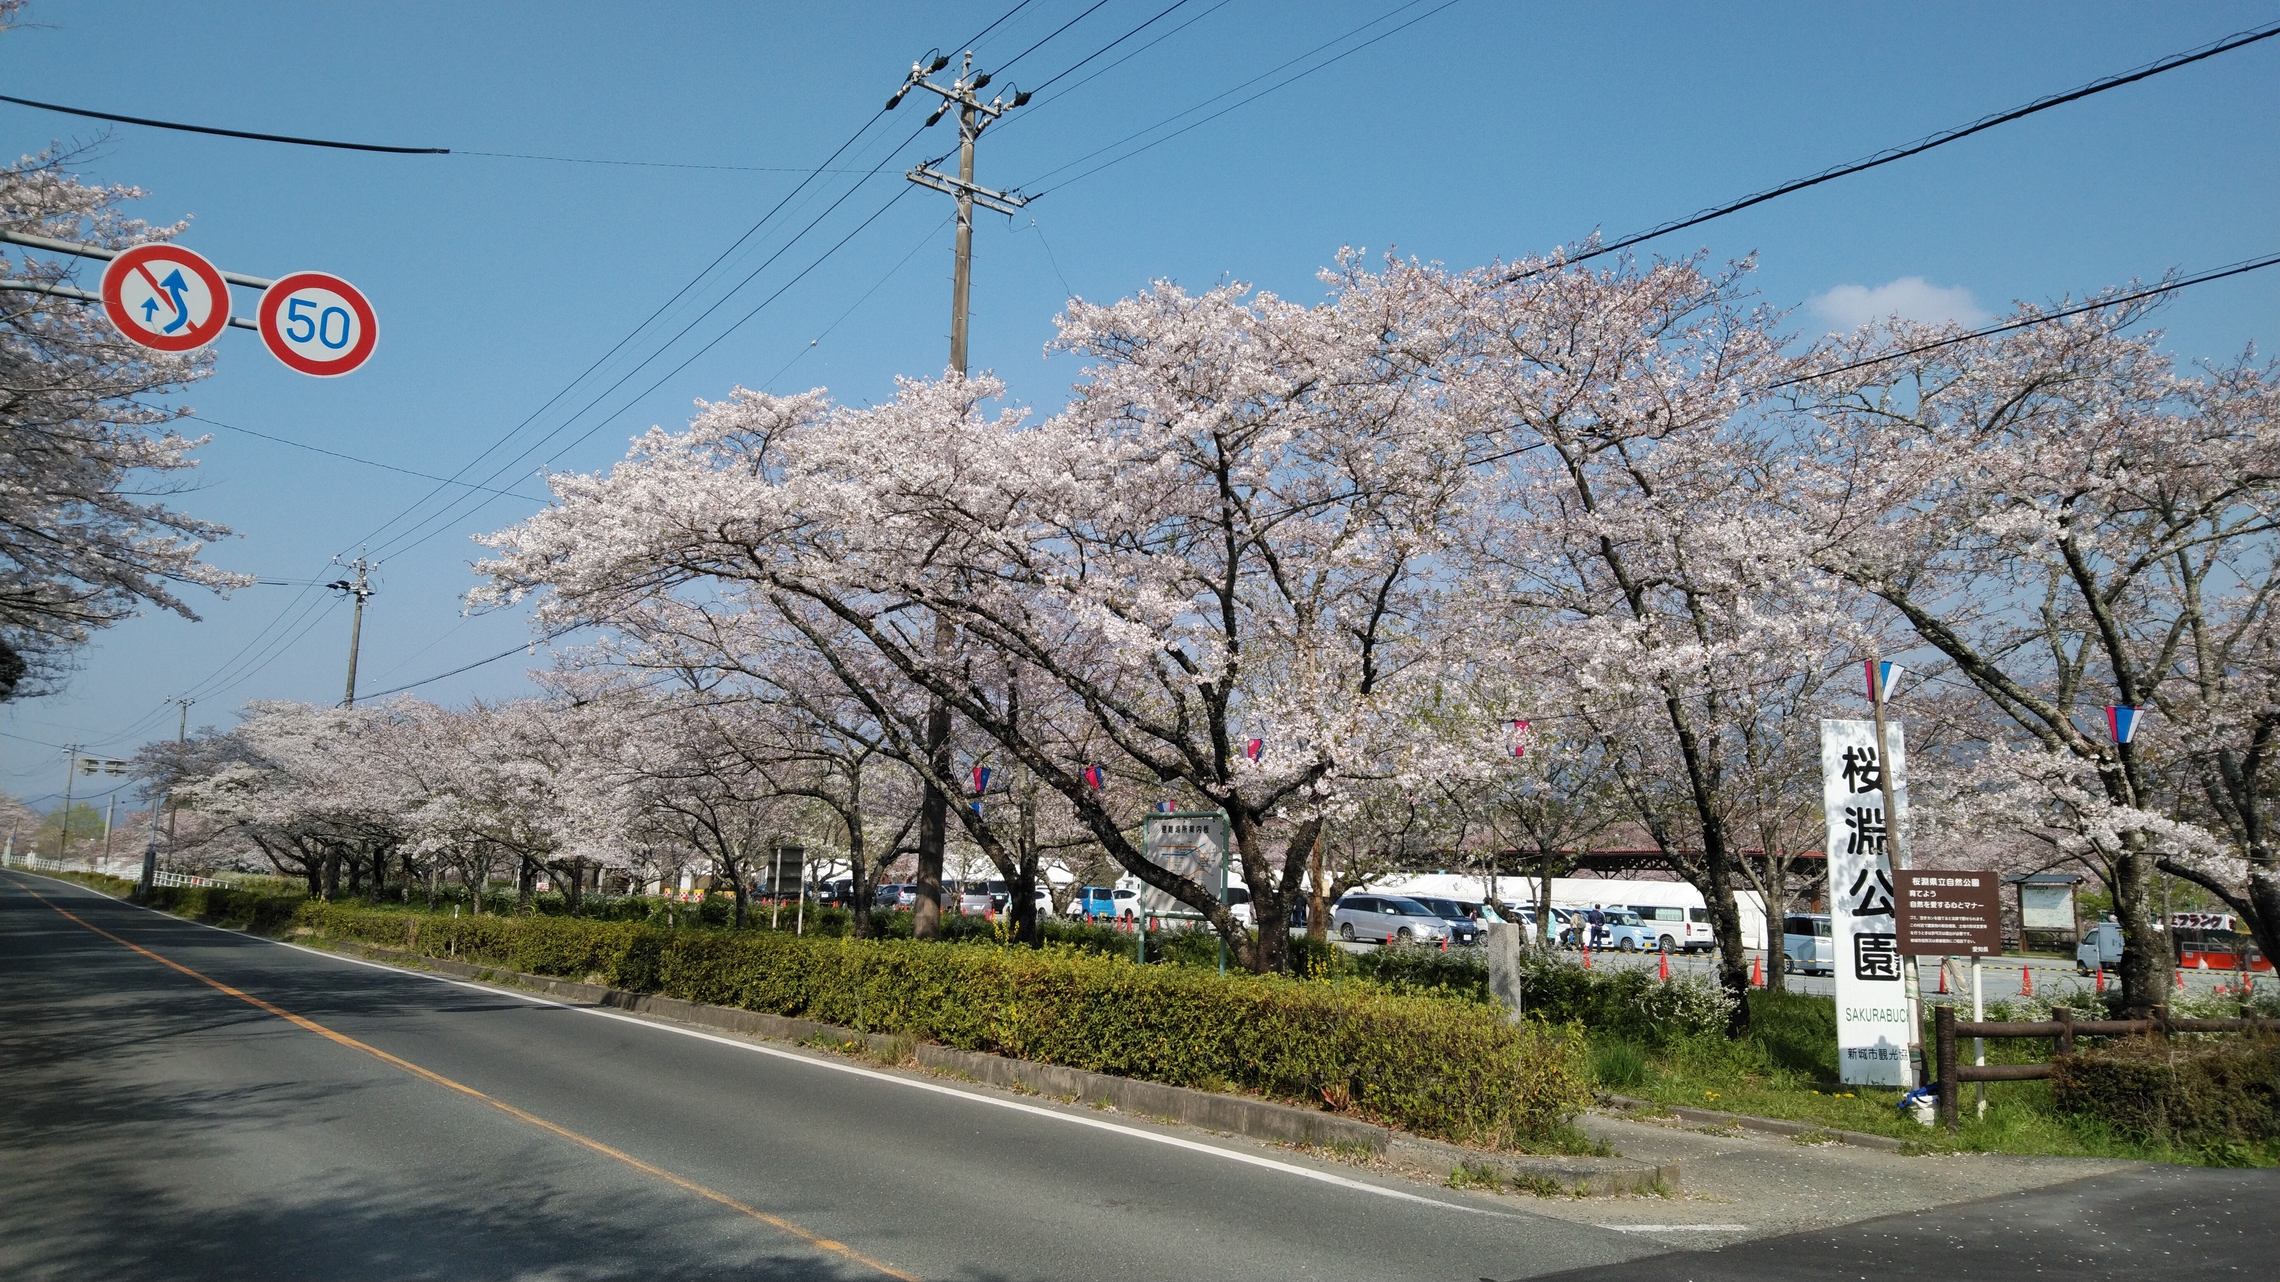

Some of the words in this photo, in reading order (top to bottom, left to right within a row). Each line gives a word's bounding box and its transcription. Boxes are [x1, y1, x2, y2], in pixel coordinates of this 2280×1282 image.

[286, 297, 351, 350] 50
[1842, 745, 1902, 982] 桜淵公園
[1912, 877, 1980, 887] 桜淵県立自然公園
[1910, 901, 1985, 909] 自然を愛する心とマナー
